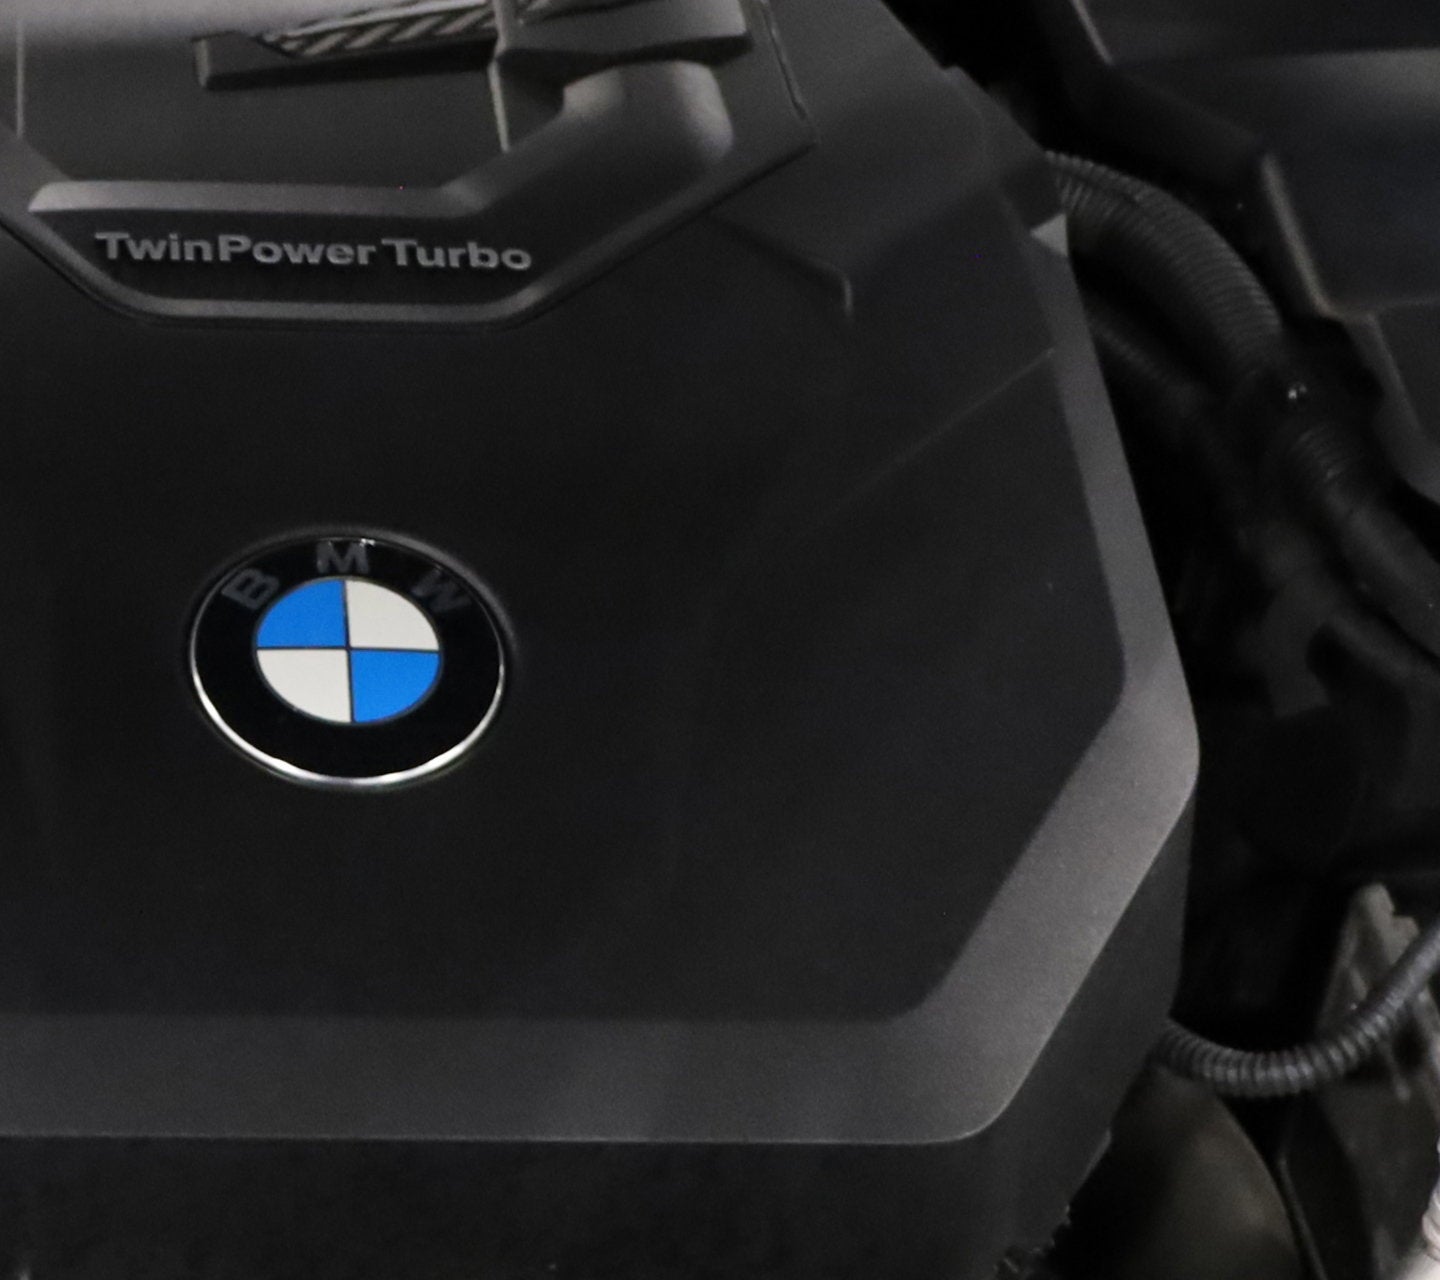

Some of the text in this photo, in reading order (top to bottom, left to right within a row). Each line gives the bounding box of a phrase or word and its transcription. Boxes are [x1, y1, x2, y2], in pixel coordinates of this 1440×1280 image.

[95, 231, 532, 270] TwinPower Turbo
[221, 539, 474, 615] BMW
